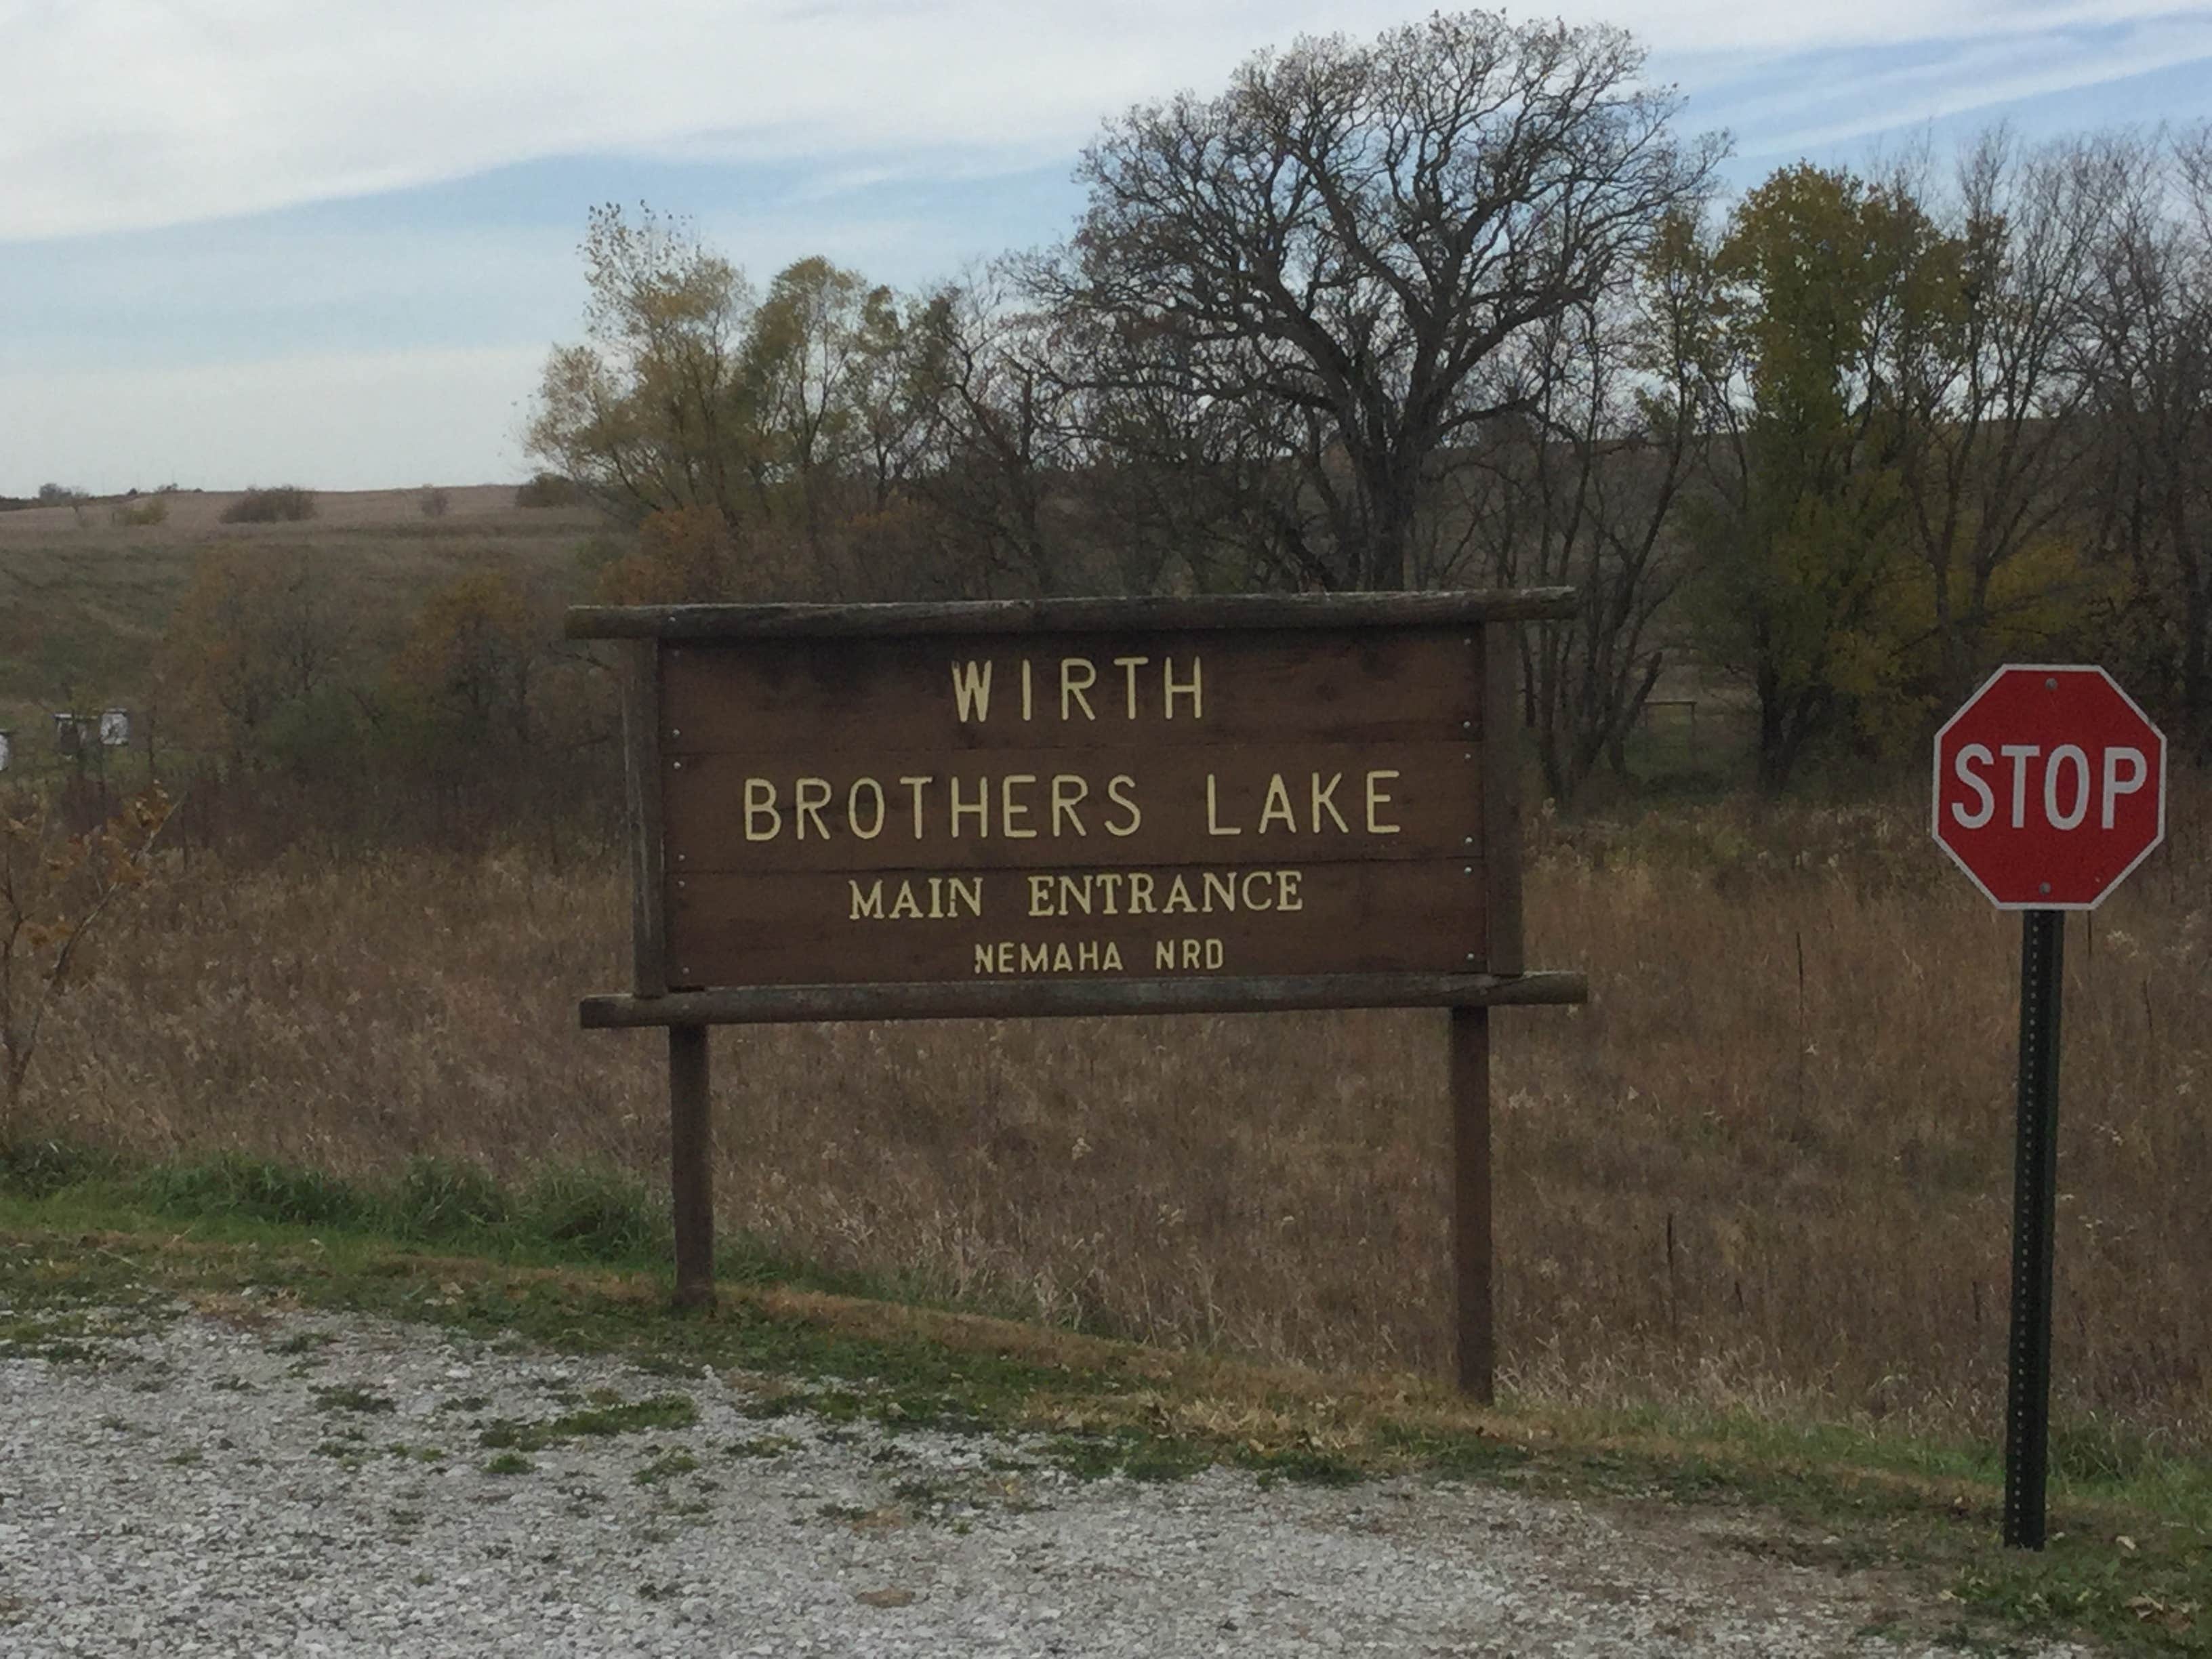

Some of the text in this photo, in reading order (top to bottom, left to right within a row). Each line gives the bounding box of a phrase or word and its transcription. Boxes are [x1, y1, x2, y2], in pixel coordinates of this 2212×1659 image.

[952, 657, 1202, 722] WIRTH
[744, 770, 1401, 841] BROTHERS LAKE
[1951, 743, 2148, 831] STOP
[848, 870, 1303, 920] MAIN ENTRANCE
[975, 939, 1223, 974] NEMAHA NRD
